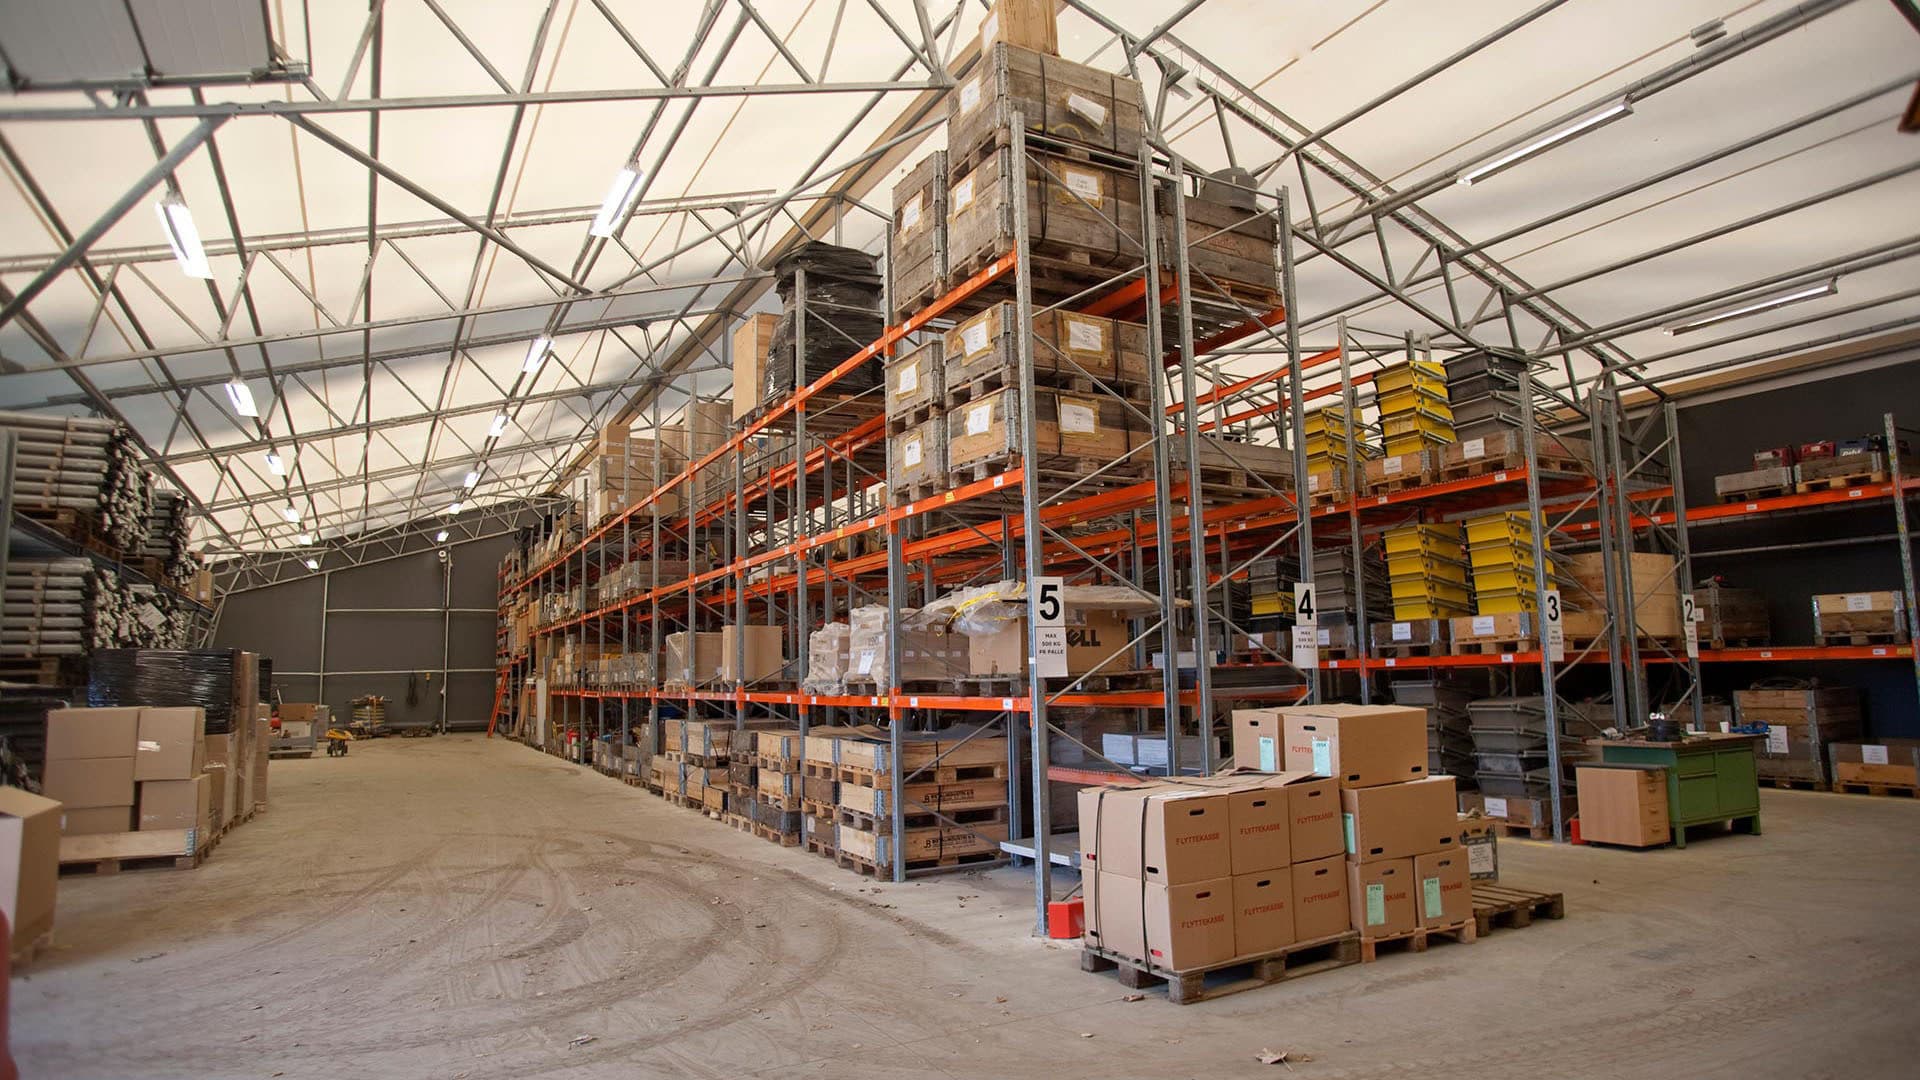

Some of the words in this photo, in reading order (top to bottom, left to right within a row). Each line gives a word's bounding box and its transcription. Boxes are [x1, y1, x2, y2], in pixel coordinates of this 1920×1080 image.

[1040, 584, 1060, 620] 5
[1299, 589, 1313, 620] 4
[1547, 595, 1559, 621] 3
[1685, 599, 1694, 622] 2
[1066, 629, 1101, 648] ELL
[1296, 811, 1334, 825] FLYTTEKASSE
[1240, 823, 1280, 835] FLYTTEKASSE
[1175, 832, 1220, 845] FLYTTEKASSE
[1303, 889, 1340, 903] FLYTTEKASSE
[1243, 902, 1284, 916] FLYTTEKASSE
[1181, 914, 1225, 929] FLYTTEKASSE
